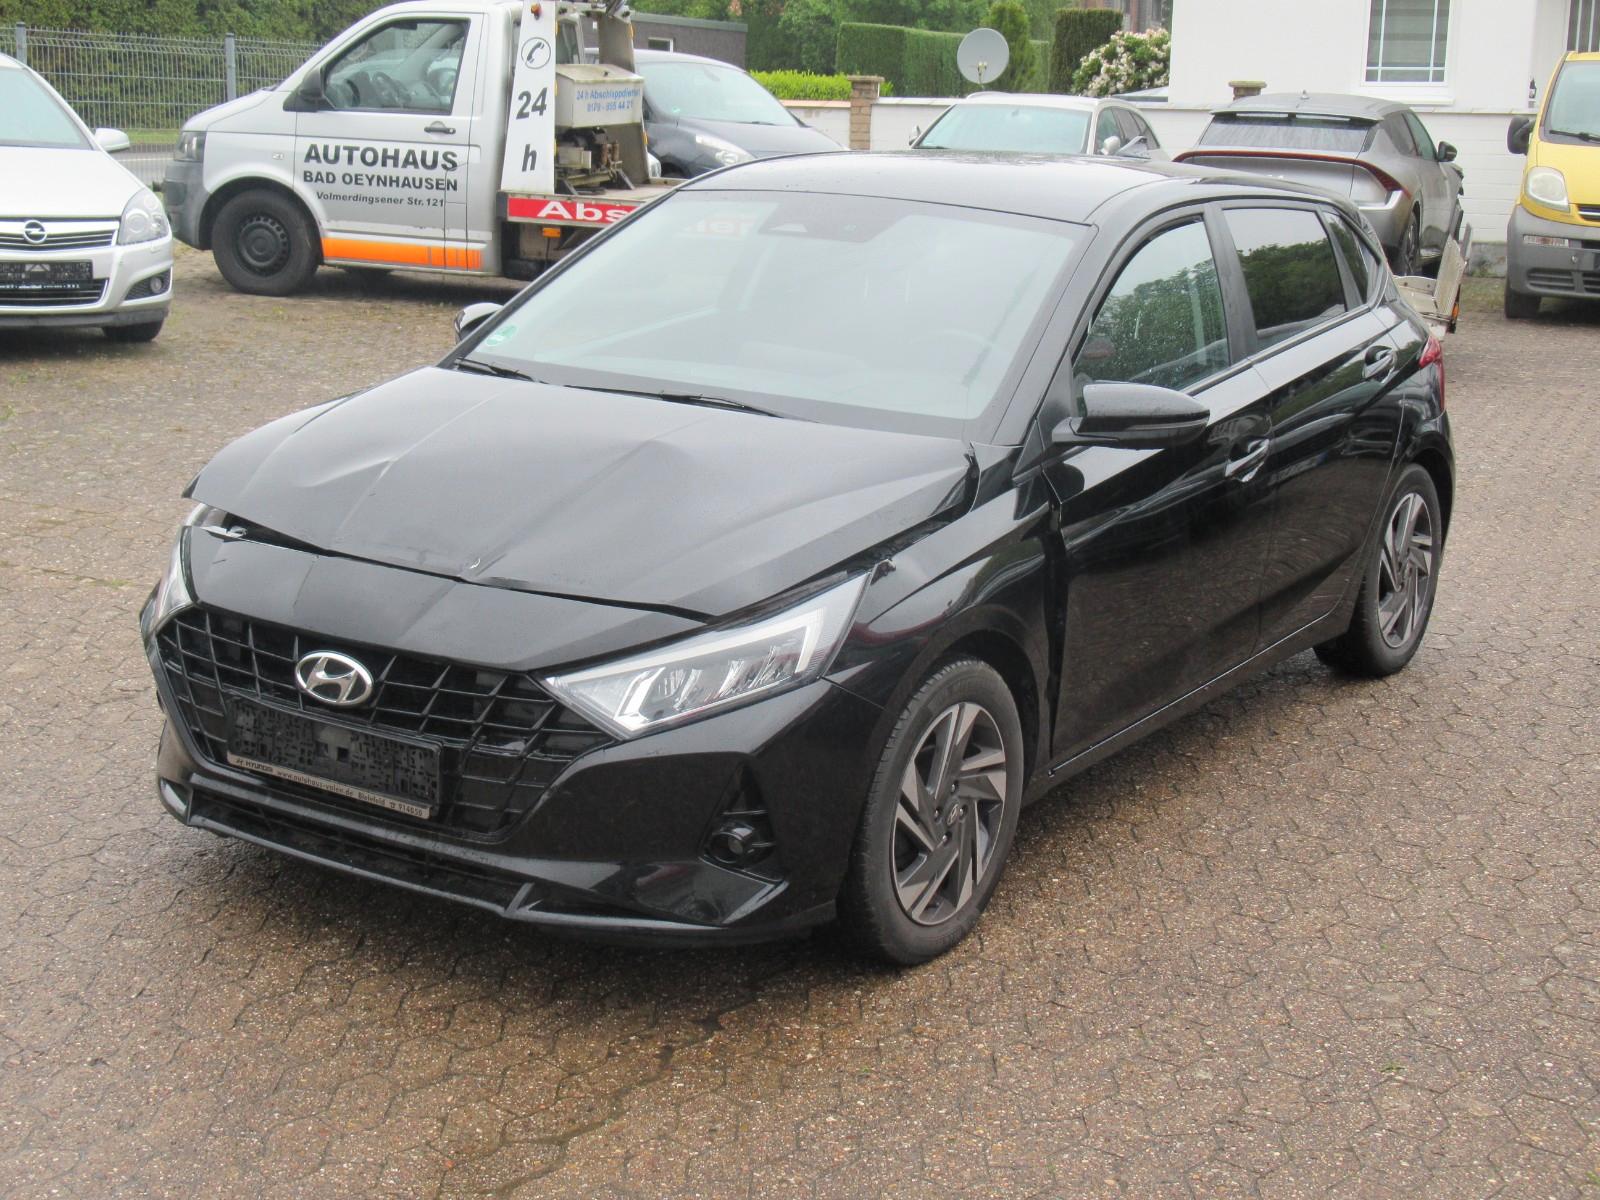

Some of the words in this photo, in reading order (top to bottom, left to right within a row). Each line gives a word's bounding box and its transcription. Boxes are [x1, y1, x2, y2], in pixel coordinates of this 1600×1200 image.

[516, 87, 548, 120] 24
[304, 143, 458, 171] AUTOHAUS
[522, 144, 537, 172] h
[303, 170, 336, 184] BAD
[341, 172, 458, 191] OEYNHAUSEN
[316, 191, 404, 205] Volmerdingsener
